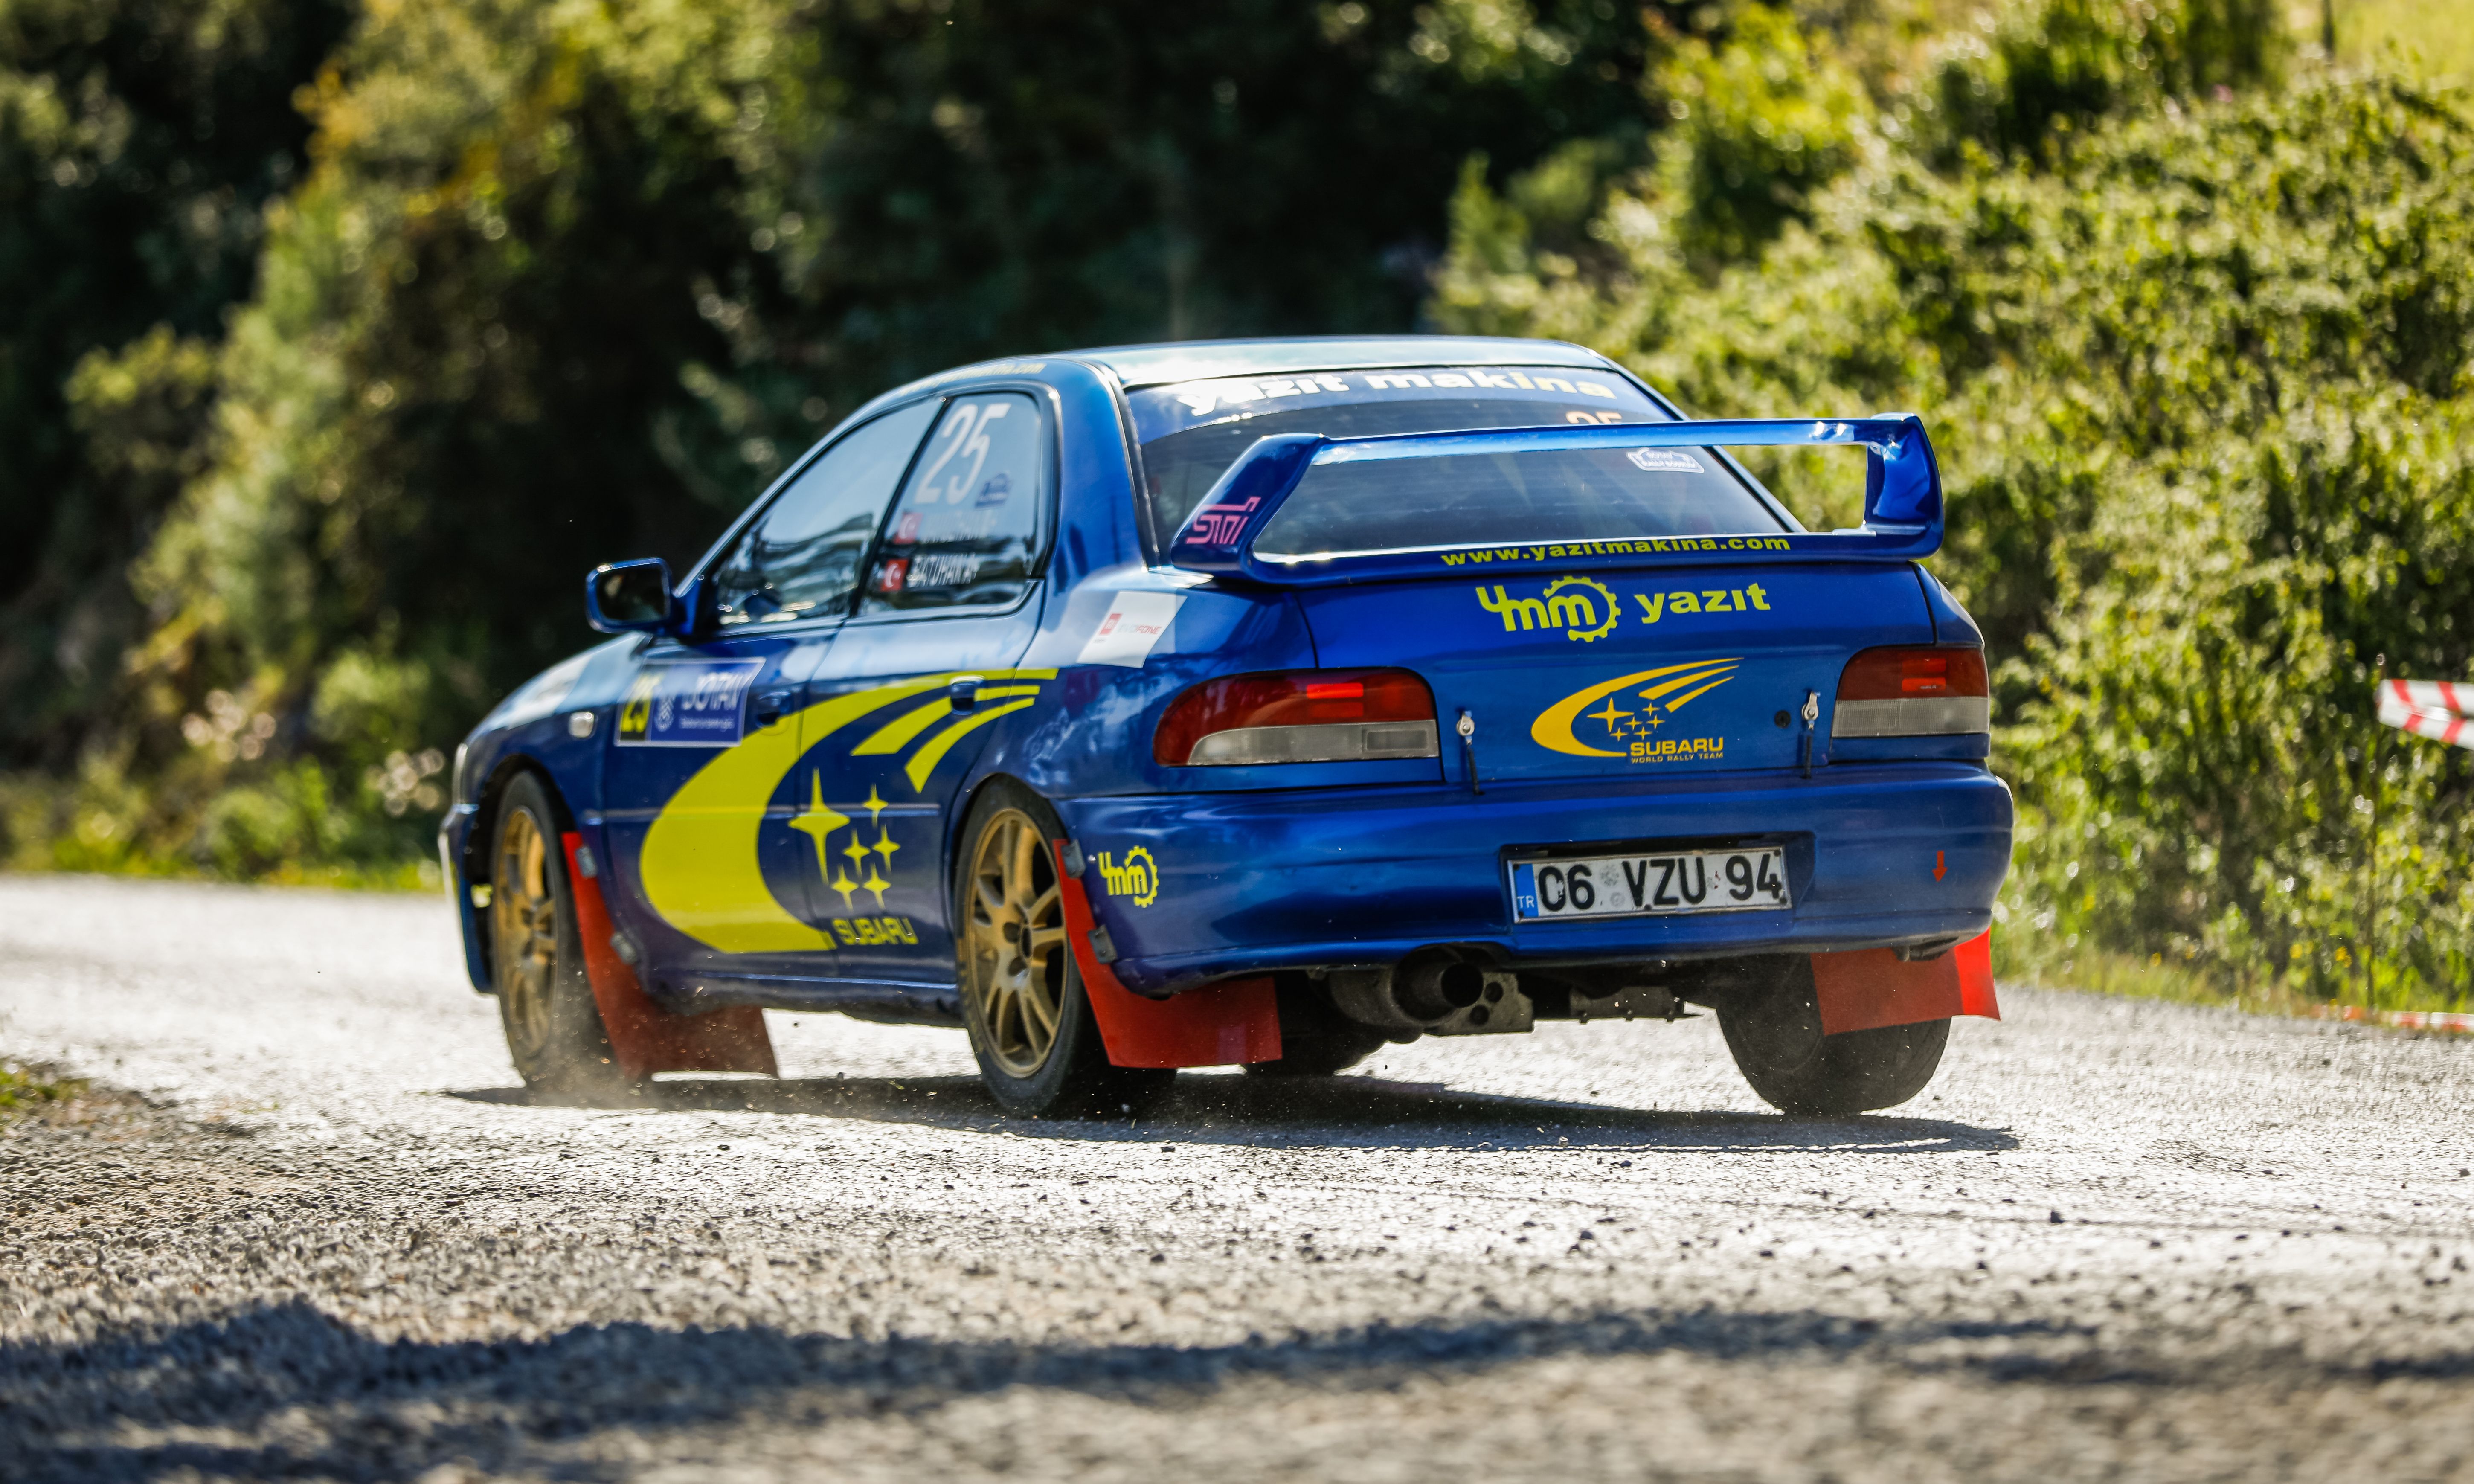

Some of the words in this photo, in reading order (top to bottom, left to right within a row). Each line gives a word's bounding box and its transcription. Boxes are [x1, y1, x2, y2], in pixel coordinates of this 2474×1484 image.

[1365, 370, 1617, 400] makina
[915, 403, 1012, 505] 25
[1441, 537, 1792, 566] www.yazitmakina.com
[1630, 736, 1724, 757] SUBARU
[1631, 755, 1664, 764] WORLD
[1667, 754, 1695, 762] RALLY
[1698, 752, 1724, 760] TEAM
[1538, 865, 1595, 912] 06
[1622, 857, 1706, 907] VZU
[1725, 853, 1782, 901] 94
[1517, 895, 1534, 909] TR
[831, 917, 919, 945] SUBARU
